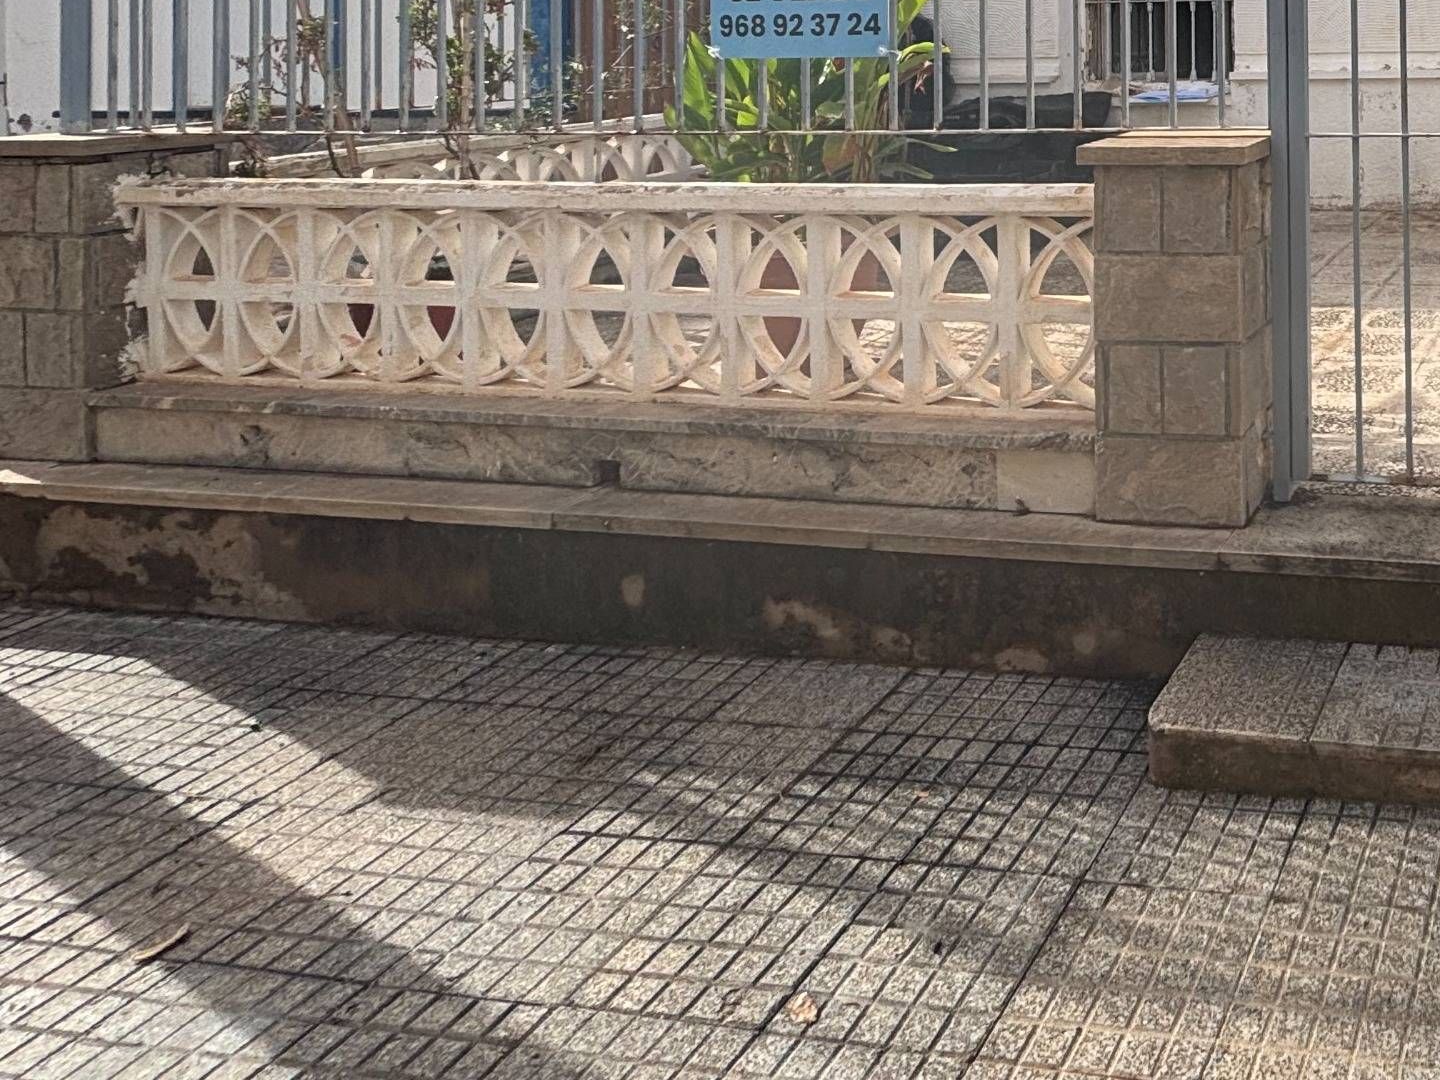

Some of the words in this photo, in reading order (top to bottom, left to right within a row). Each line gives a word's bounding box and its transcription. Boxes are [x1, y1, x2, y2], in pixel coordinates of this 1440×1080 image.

[719, 14, 766, 37] 968
[773, 14, 804, 37] 92
[810, 13, 841, 36] 37
[847, 13, 881, 36] 24
